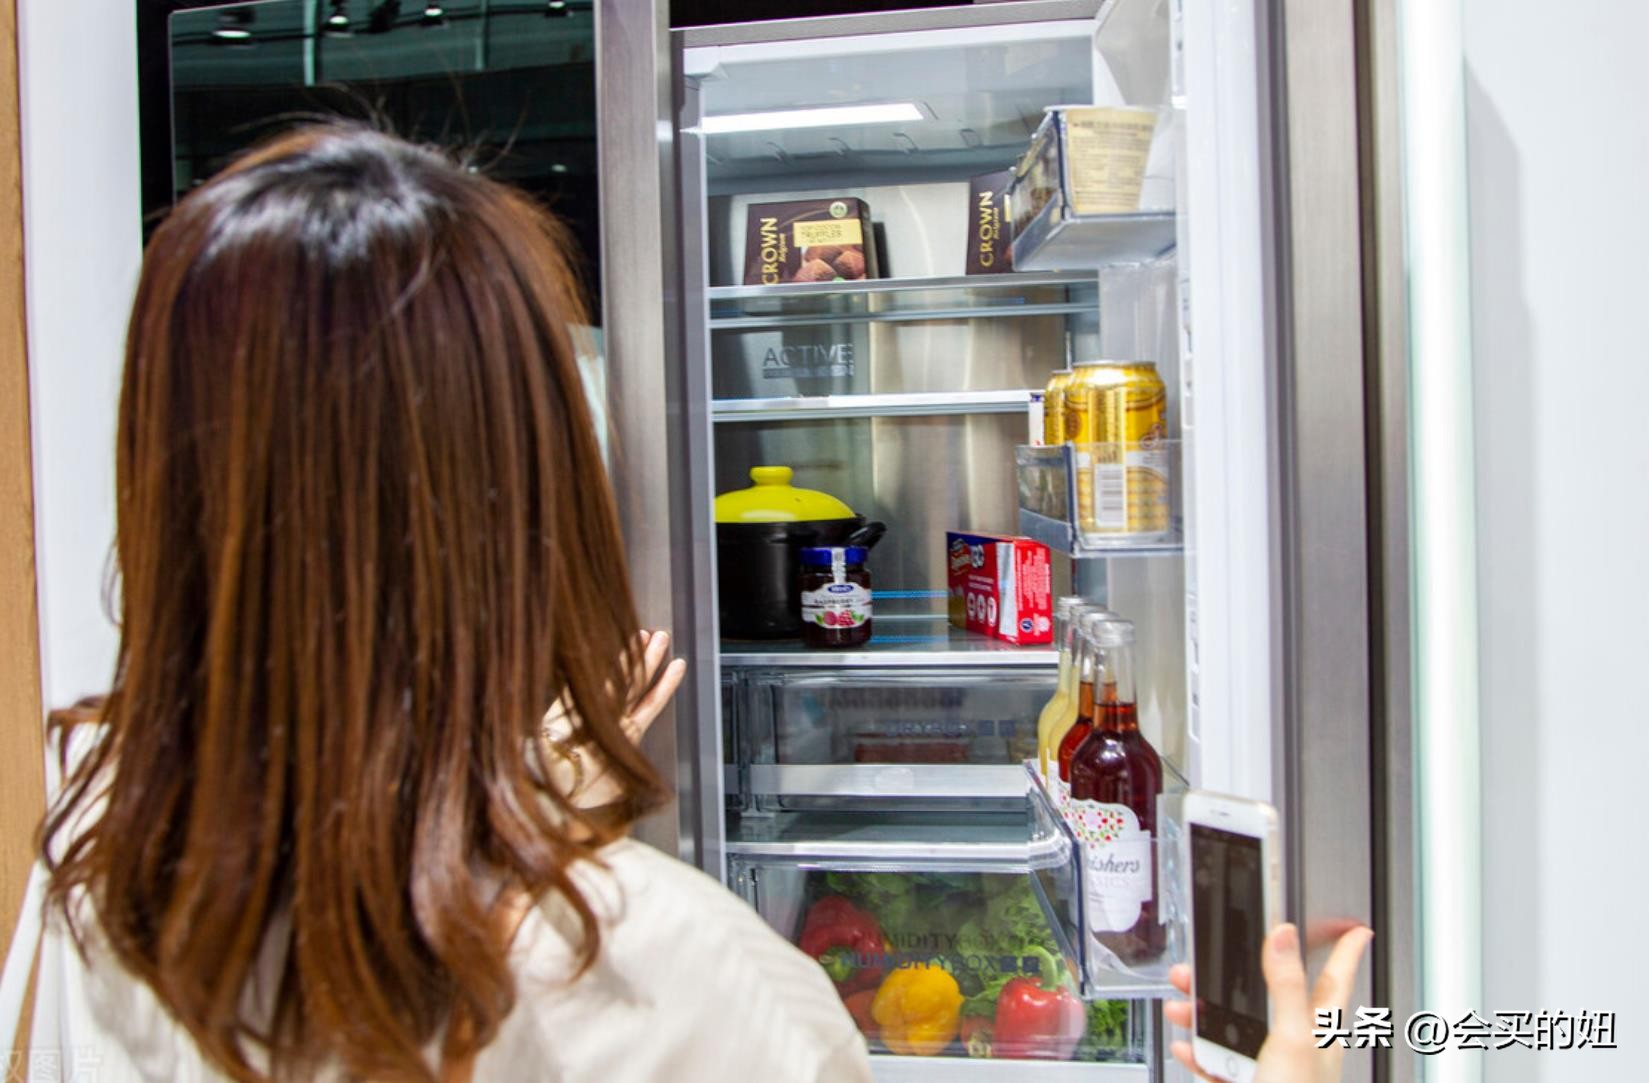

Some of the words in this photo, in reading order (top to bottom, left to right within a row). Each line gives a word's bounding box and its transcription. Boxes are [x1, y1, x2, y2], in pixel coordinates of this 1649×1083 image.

[760, 217, 779, 284] CROWN
[978, 190, 994, 268] CROWN
[762, 343, 855, 368] ACTIVE
